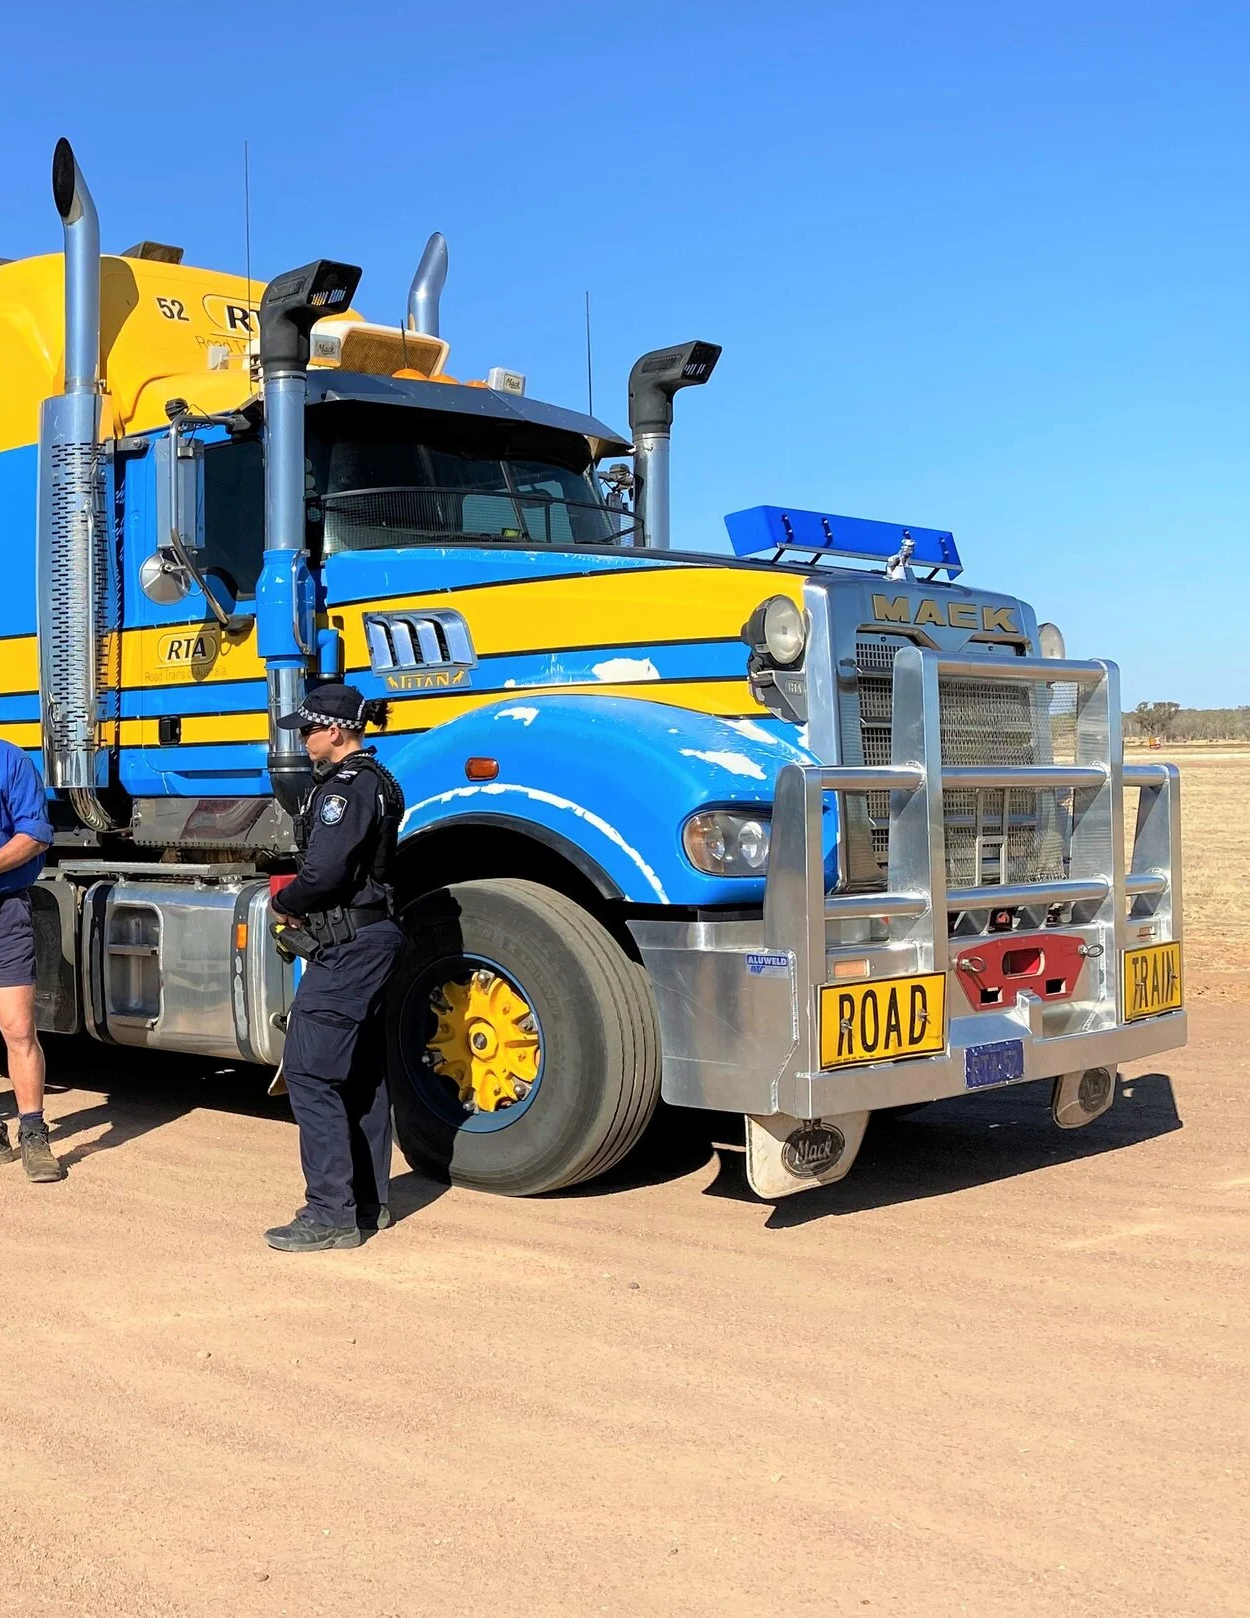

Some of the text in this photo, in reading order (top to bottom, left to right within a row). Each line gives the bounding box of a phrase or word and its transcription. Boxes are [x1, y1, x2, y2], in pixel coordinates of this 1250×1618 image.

[156, 297, 190, 322] 52
[316, 344, 334, 353] Mack
[872, 594, 1019, 633] MACK
[167, 637, 207, 661] RTA
[747, 956, 787, 966] ALUWELD
[1132, 949, 1175, 1011] TRAIN
[837, 984, 929, 1057] ROAD
[793, 1134, 832, 1166] Mack
